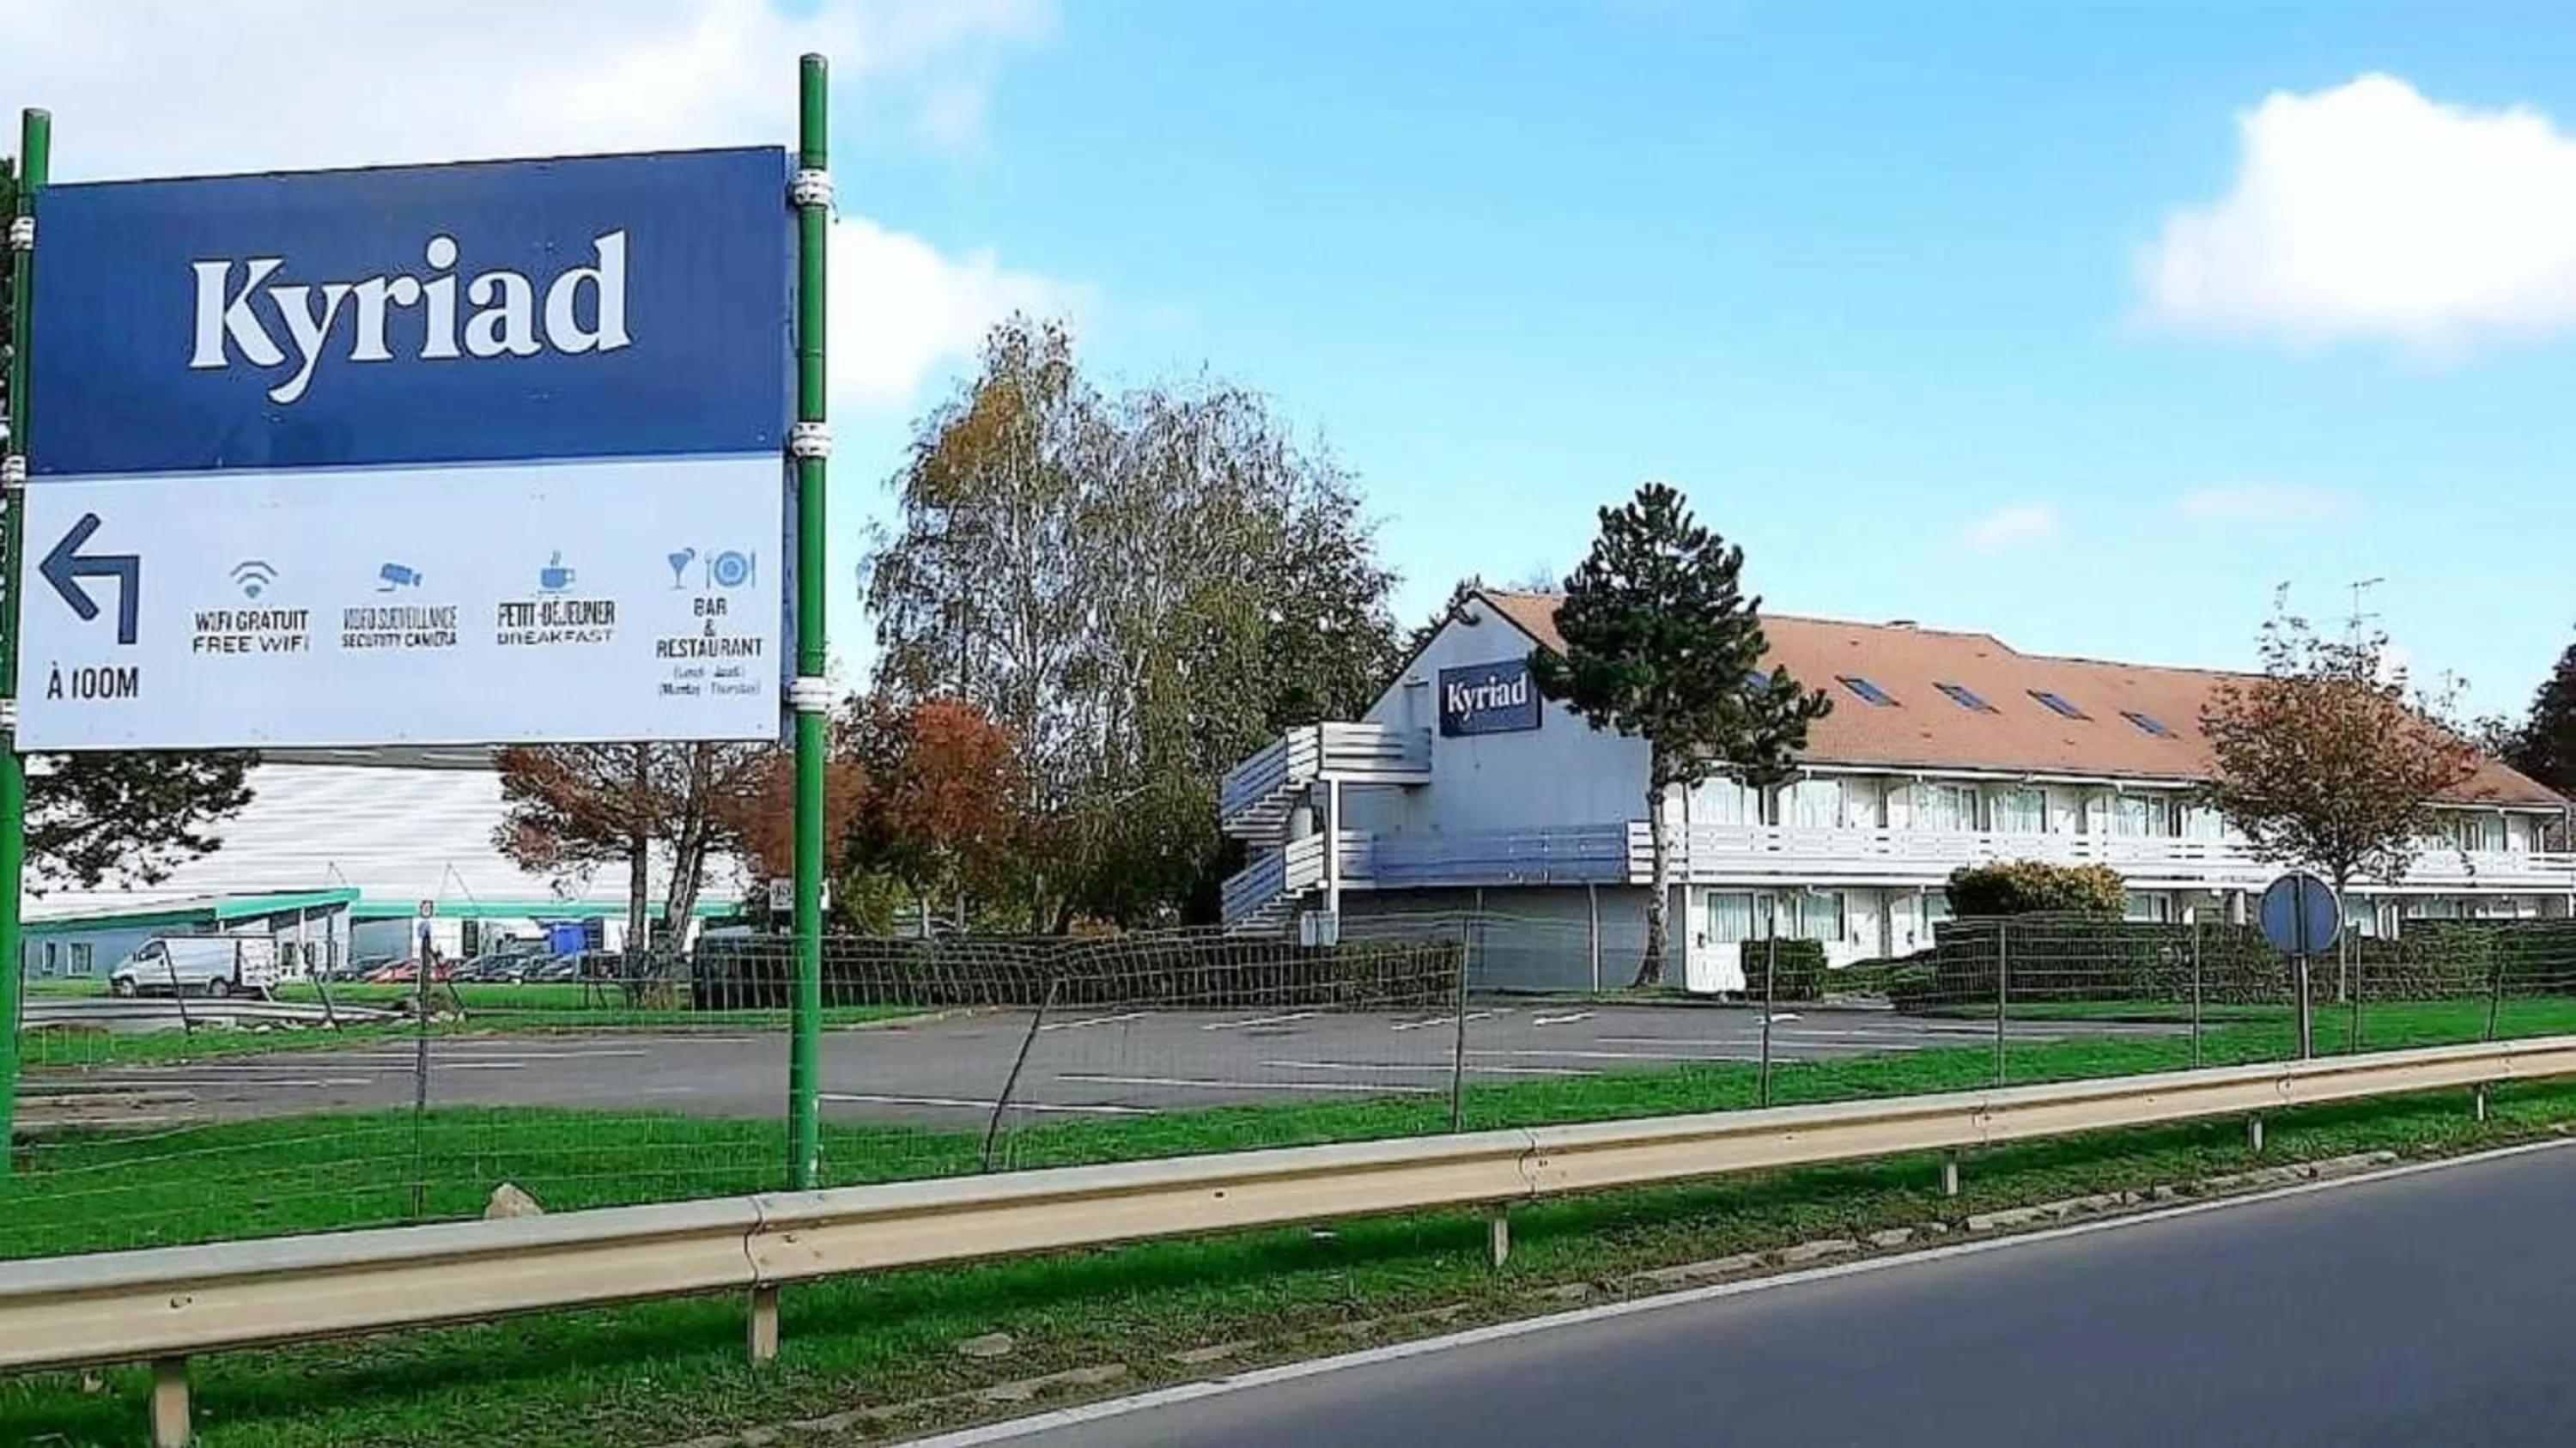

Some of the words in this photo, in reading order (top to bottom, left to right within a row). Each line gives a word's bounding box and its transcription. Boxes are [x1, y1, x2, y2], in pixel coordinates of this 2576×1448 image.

[189, 231, 630, 403] Kyriad
[694, 597, 727, 617] BAR
[236, 609, 308, 631] GRATUIT
[704, 618, 715, 637] &
[192, 636, 252, 654] FREE
[258, 635, 310, 653] WIFI
[656, 637, 762, 659] RESTAURANT
[47, 661, 63, 700] À
[72, 666, 139, 699] 100M
[1447, 672, 1528, 721] Kyriad
